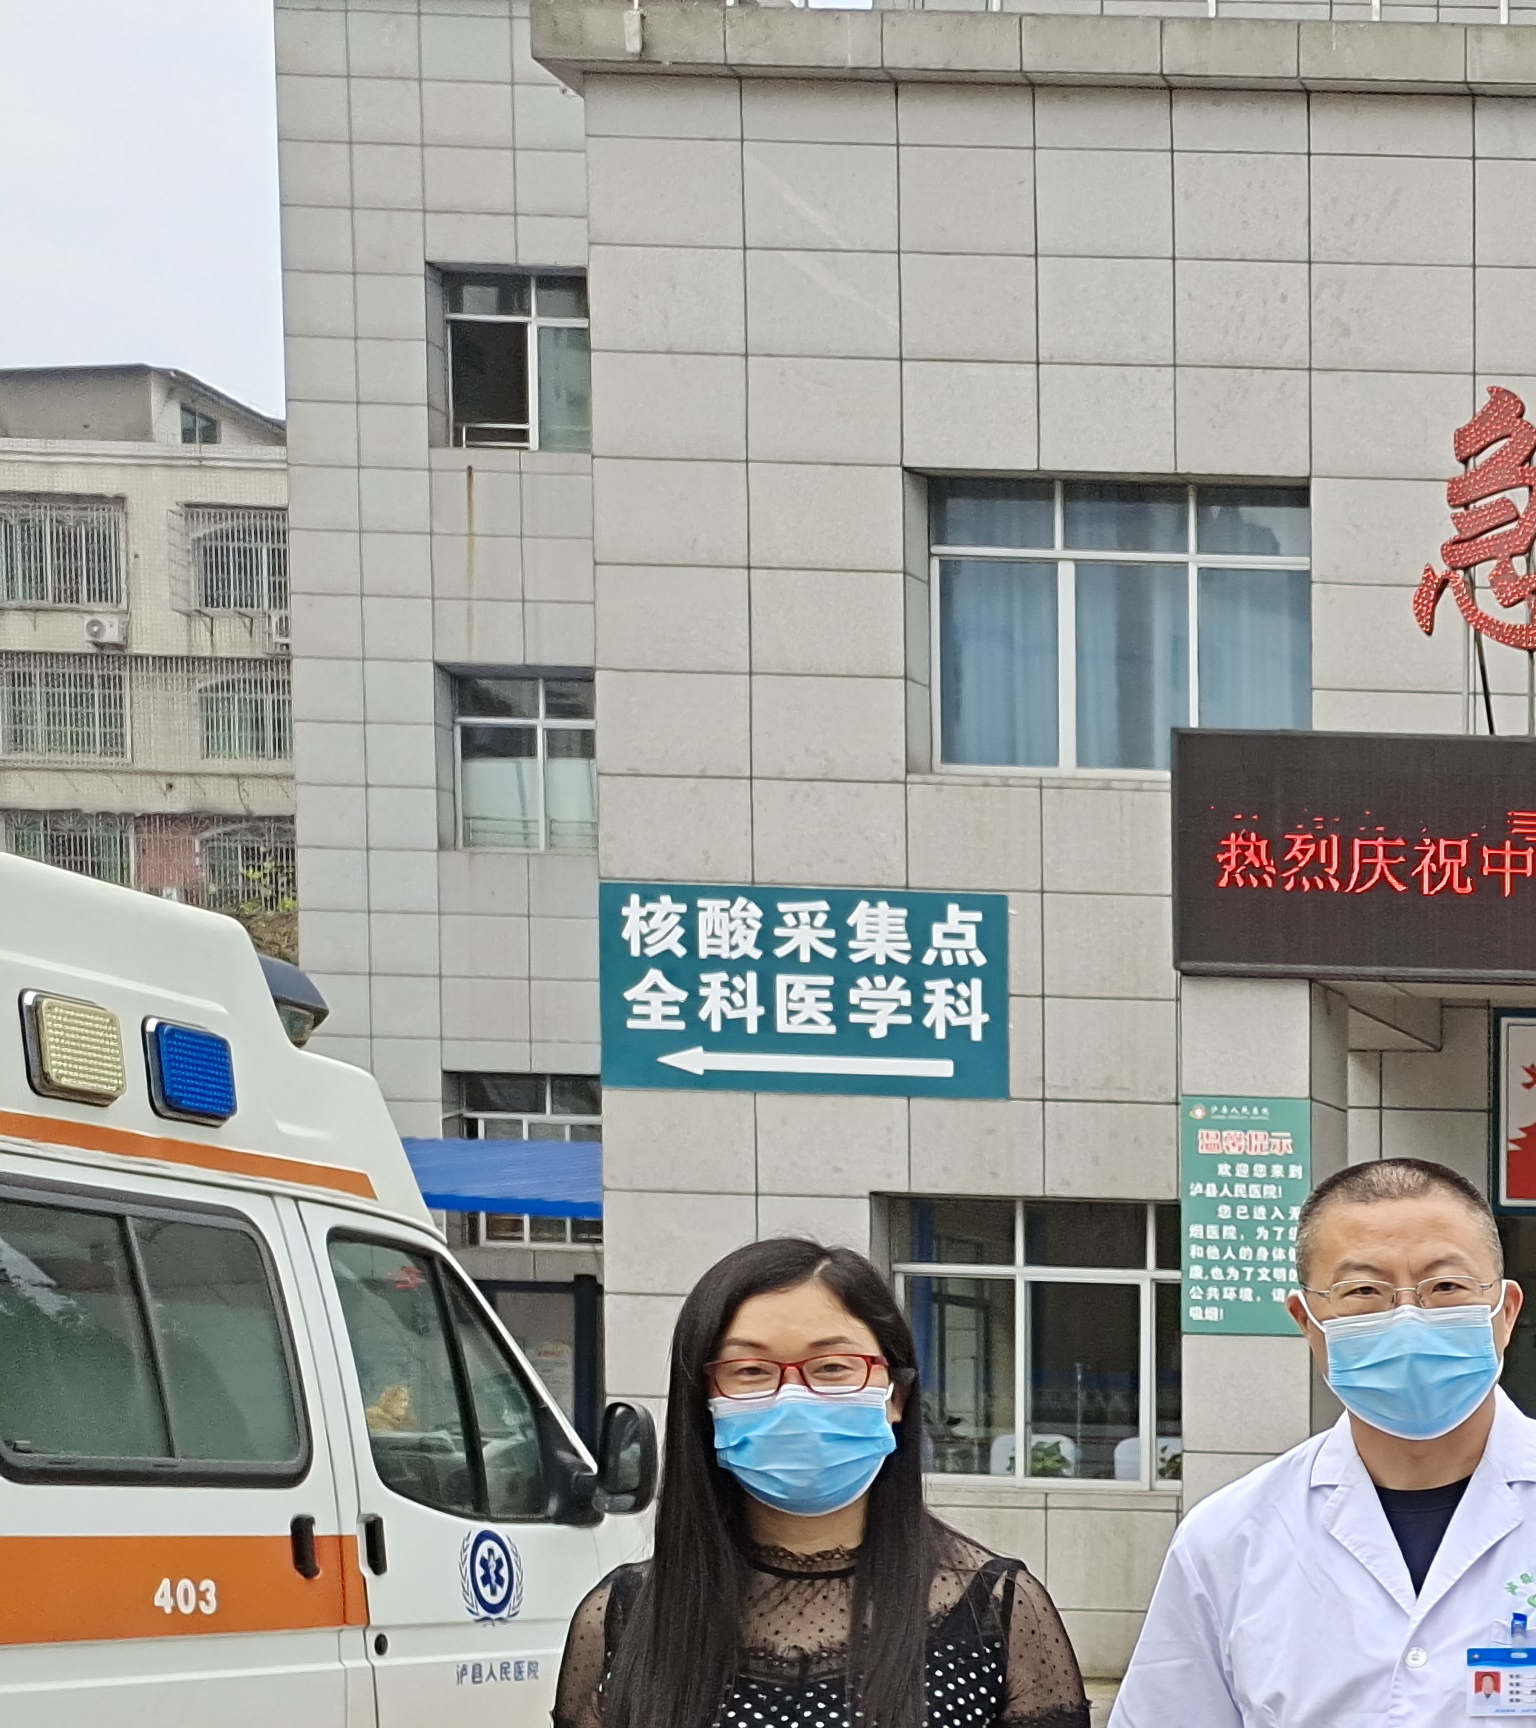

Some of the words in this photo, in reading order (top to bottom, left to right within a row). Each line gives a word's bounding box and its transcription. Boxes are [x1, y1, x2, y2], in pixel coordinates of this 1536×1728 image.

[620, 894, 987, 967] 核酸采集点
[623, 968, 990, 1042] 全科医学科
[1197, 1128, 1295, 1156] 温馨提示
[153, 1578, 218, 1616] 403
[456, 1660, 540, 1686] 泸县人民医院
